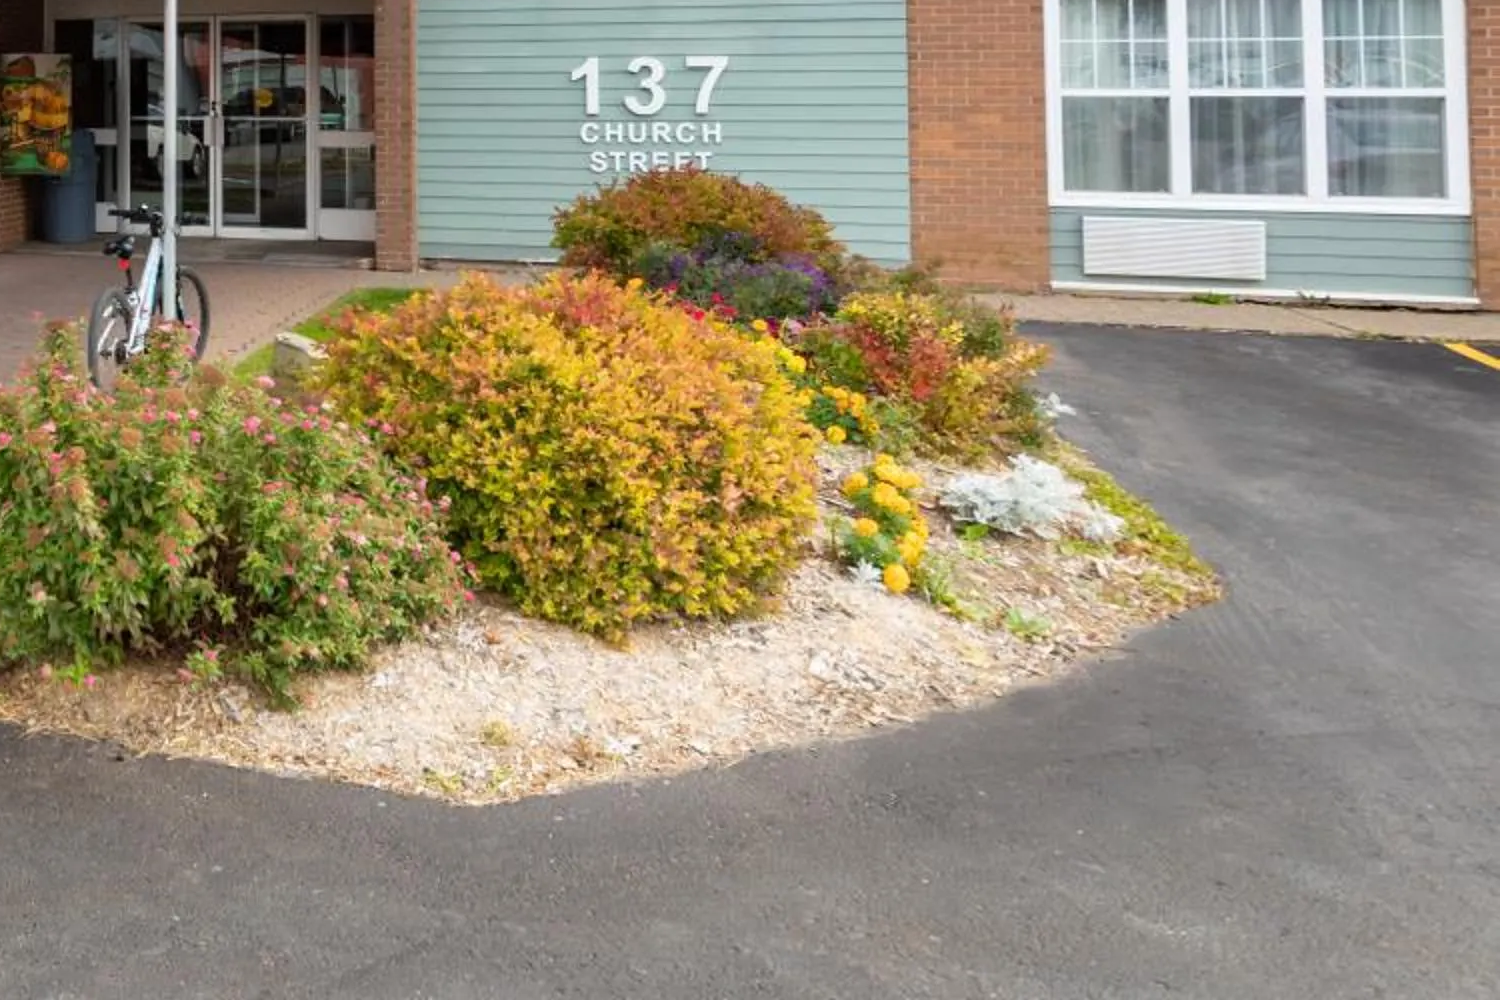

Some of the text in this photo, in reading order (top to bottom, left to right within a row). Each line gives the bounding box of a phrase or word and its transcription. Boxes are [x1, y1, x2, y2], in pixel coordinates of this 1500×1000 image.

[570, 55, 730, 116] 137
[579, 121, 723, 144] CHURCH
[589, 151, 713, 173] STREET
